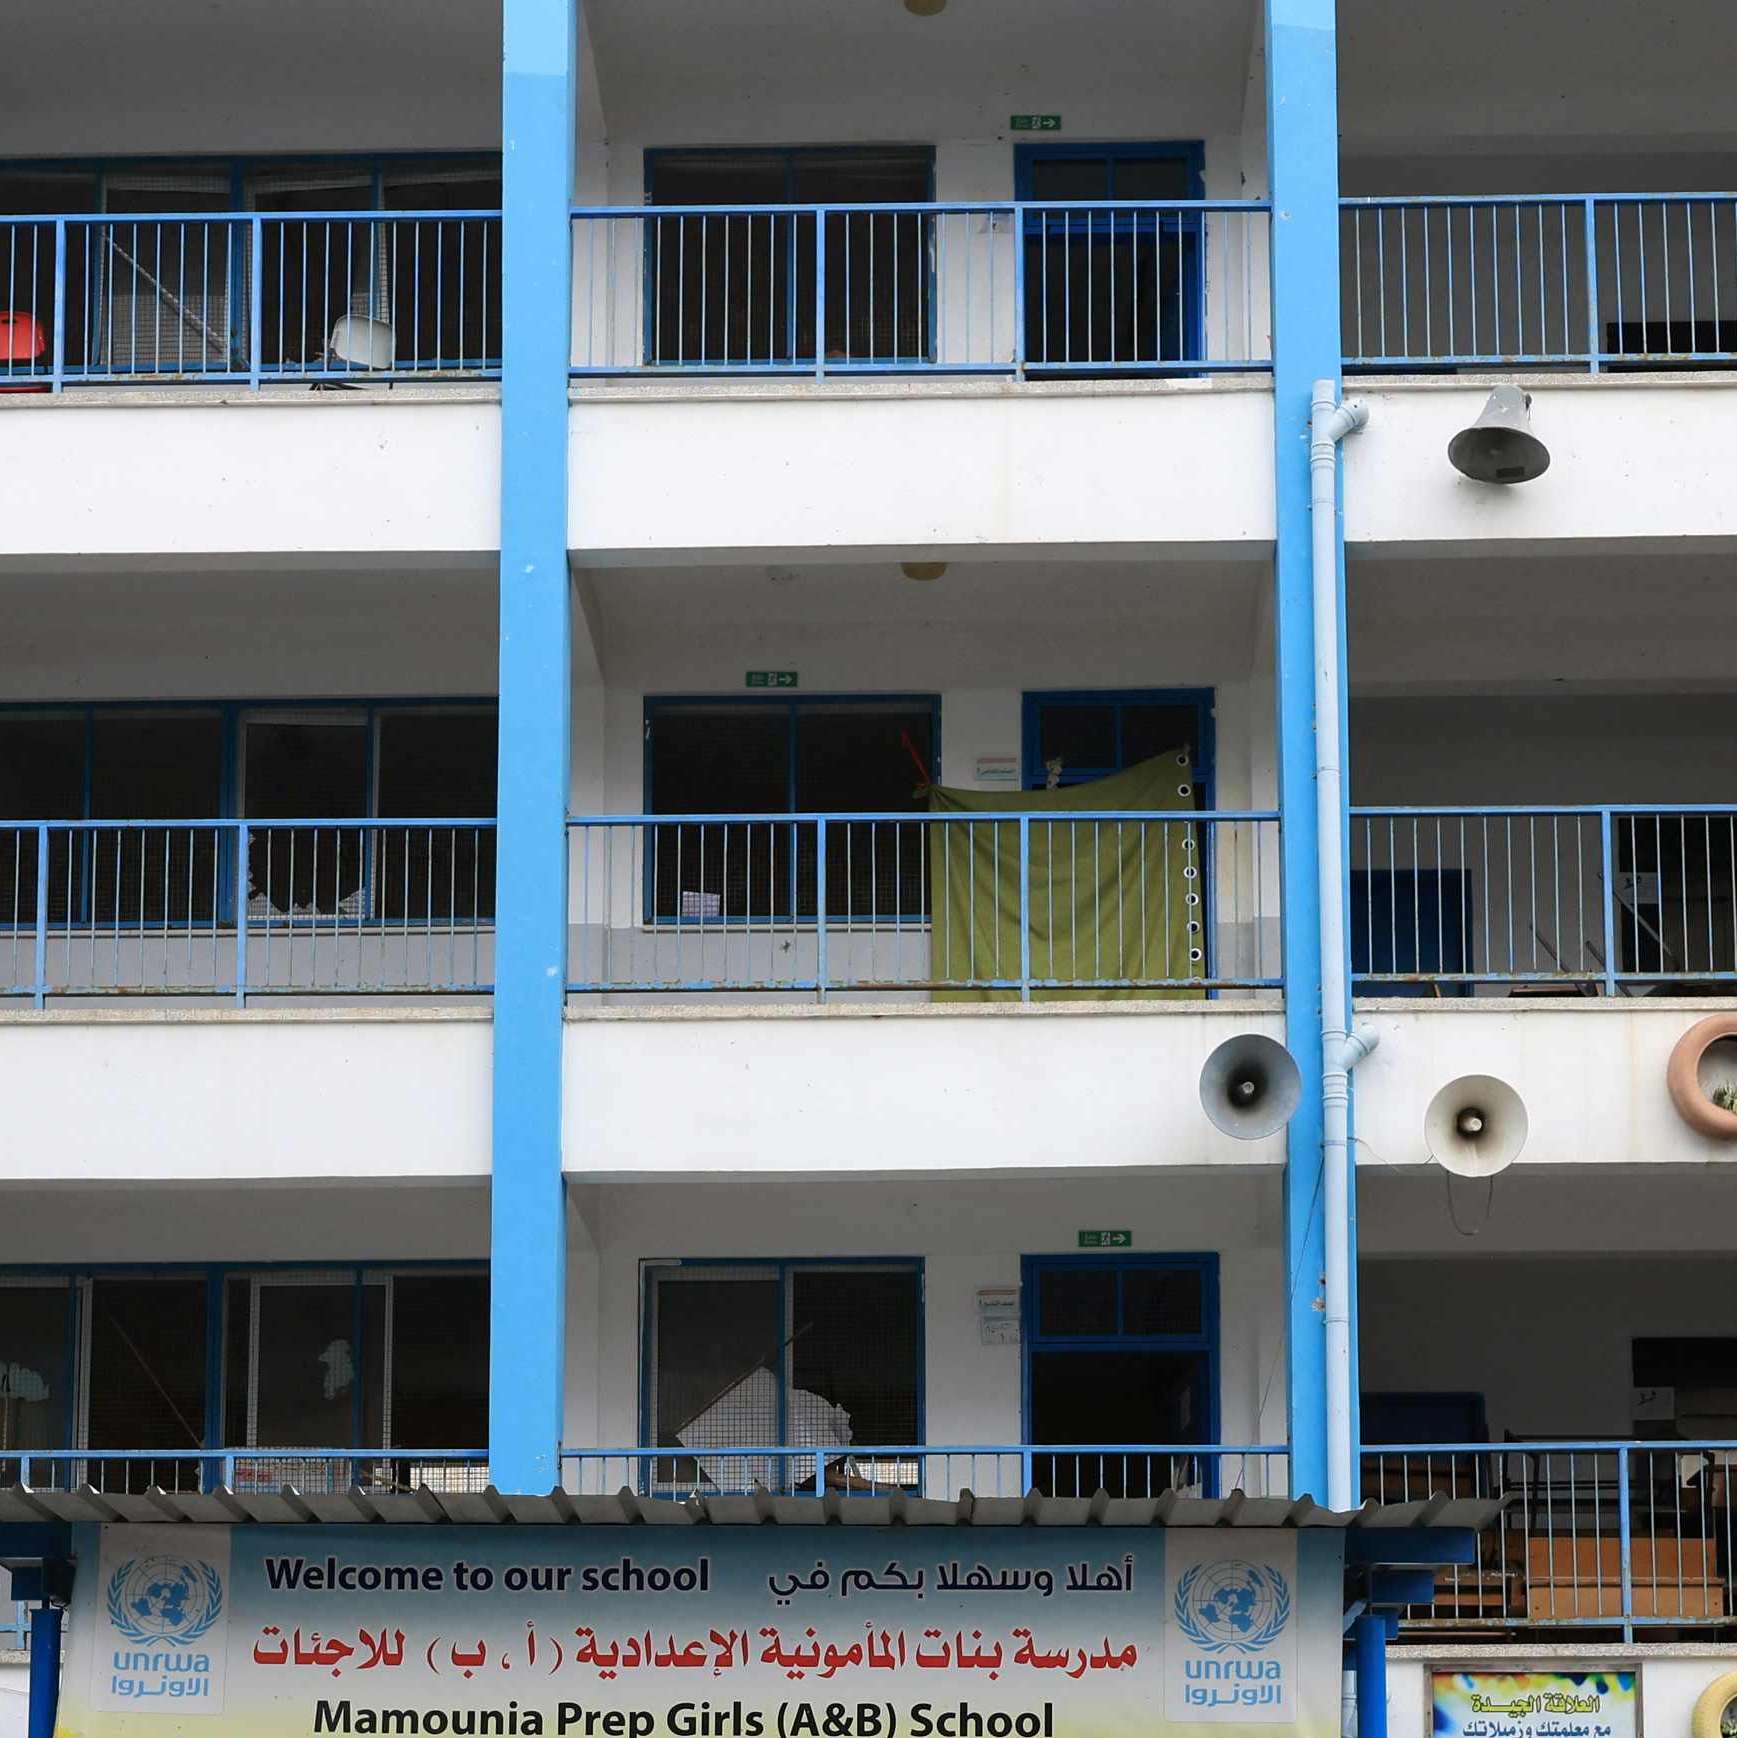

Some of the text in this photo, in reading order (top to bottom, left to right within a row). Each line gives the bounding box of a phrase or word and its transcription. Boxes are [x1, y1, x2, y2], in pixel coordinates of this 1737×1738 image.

[265, 1557, 709, 1592] Welcome to our school
[768, 1554, 1134, 1606] أهلا وسهلا بكم في
[112, 1652, 211, 1673] unrwa
[252, 1624, 407, 1678] للاجئات
[575, 1625, 749, 1680] الإعدادية
[759, 1619, 906, 1680] المأمونية
[915, 1627, 1004, 1681] بنات
[1013, 1627, 1139, 1680] مدرسة
[1184, 1659, 1282, 1681] unrwa
[313, 1700, 544, 1737] Mamounia
[666, 1701, 764, 1738] Girls
[909, 1702, 1054, 1738] School
[1470, 1693, 1600, 1718] العلاقة الجيدة
[1535, 1719, 1591, 1738] معلمتك
